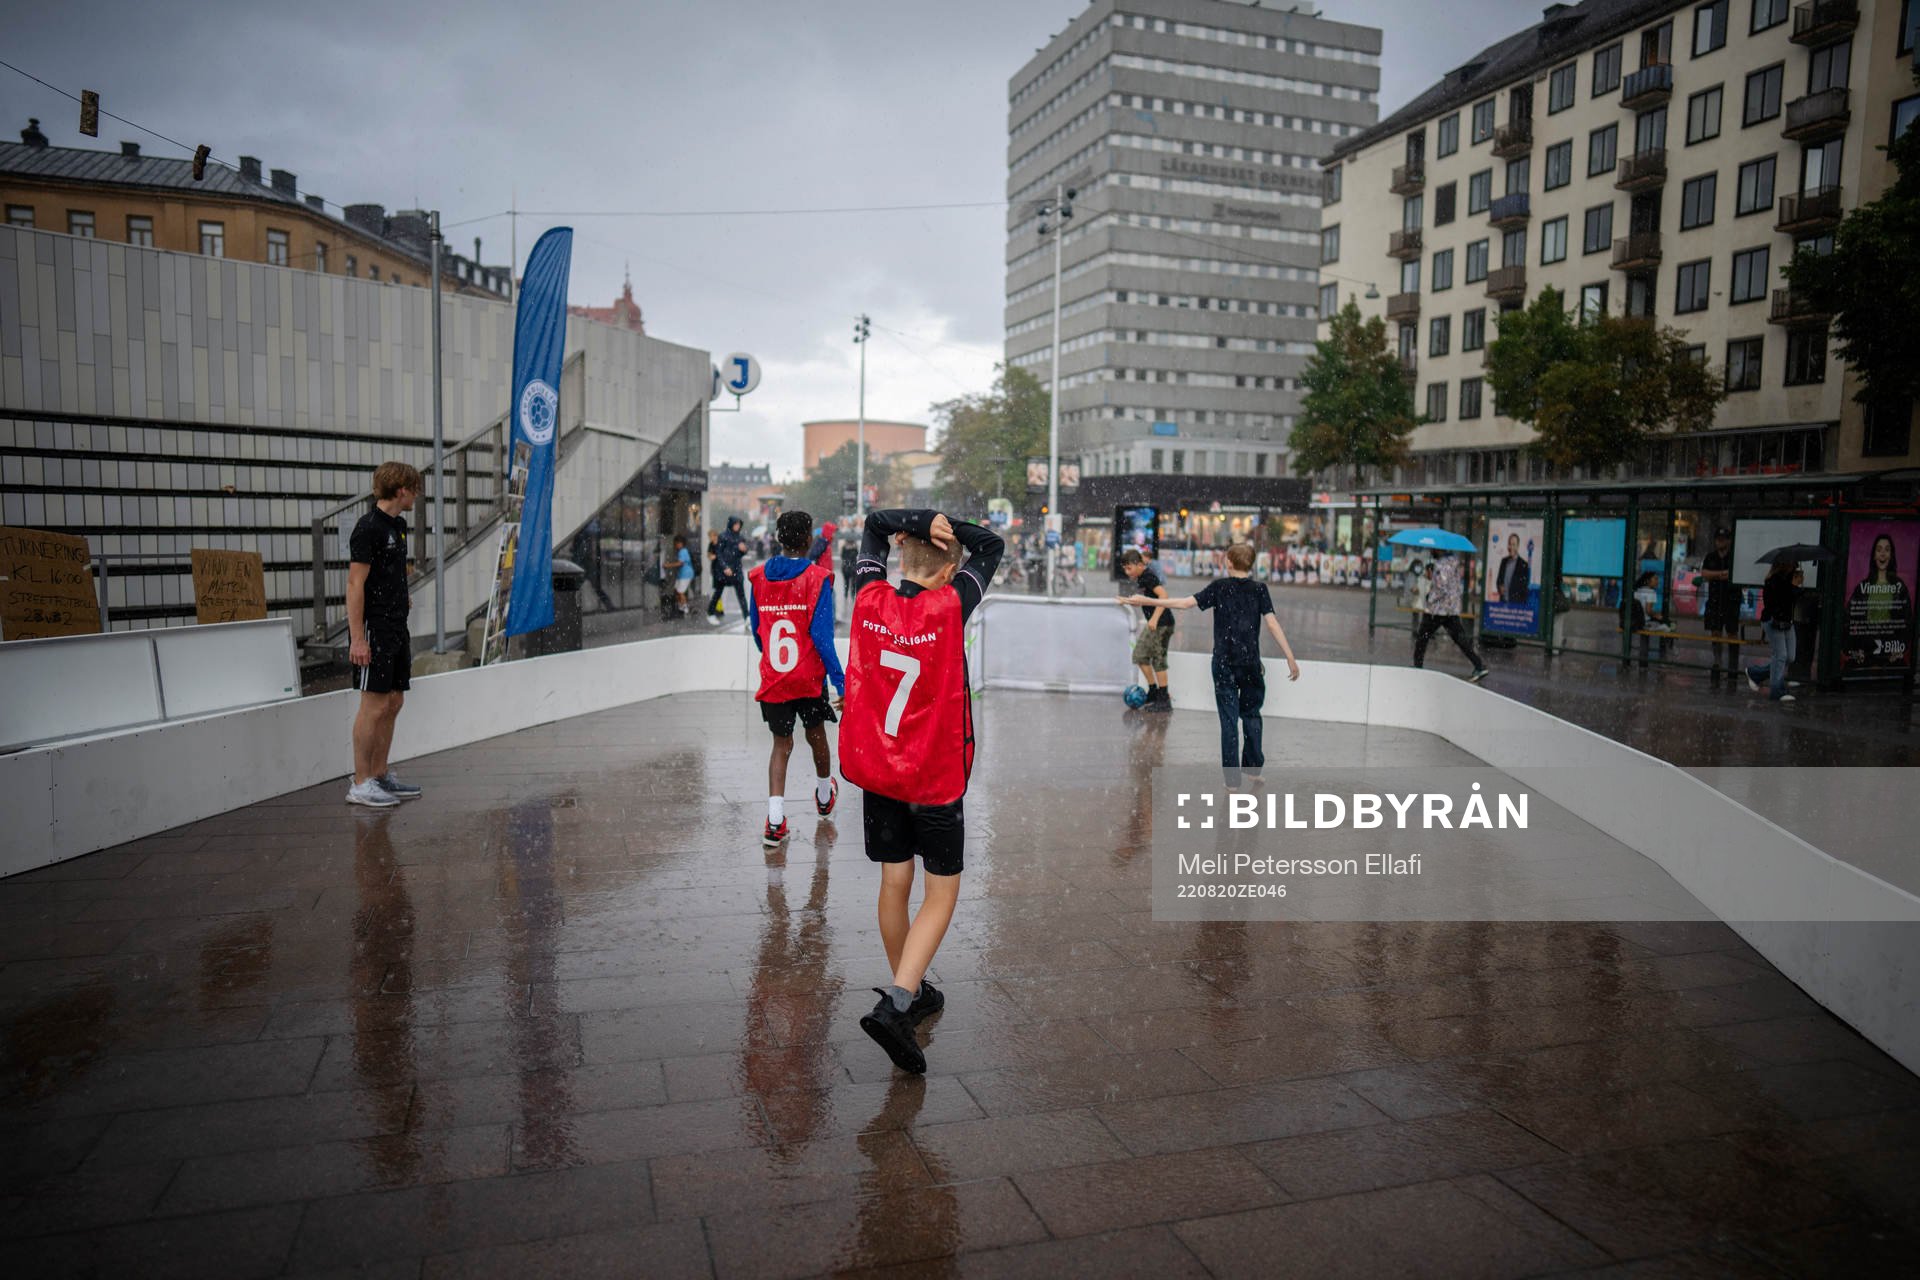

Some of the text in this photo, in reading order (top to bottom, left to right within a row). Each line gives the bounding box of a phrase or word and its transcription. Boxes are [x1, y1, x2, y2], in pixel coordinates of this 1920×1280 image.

[731, 358, 749, 389] J
[50, 567, 83, 585] 16:00
[1860, 582, 1902, 594] Vinnare?
[769, 619, 799, 673] 6
[880, 649, 920, 737] 7
